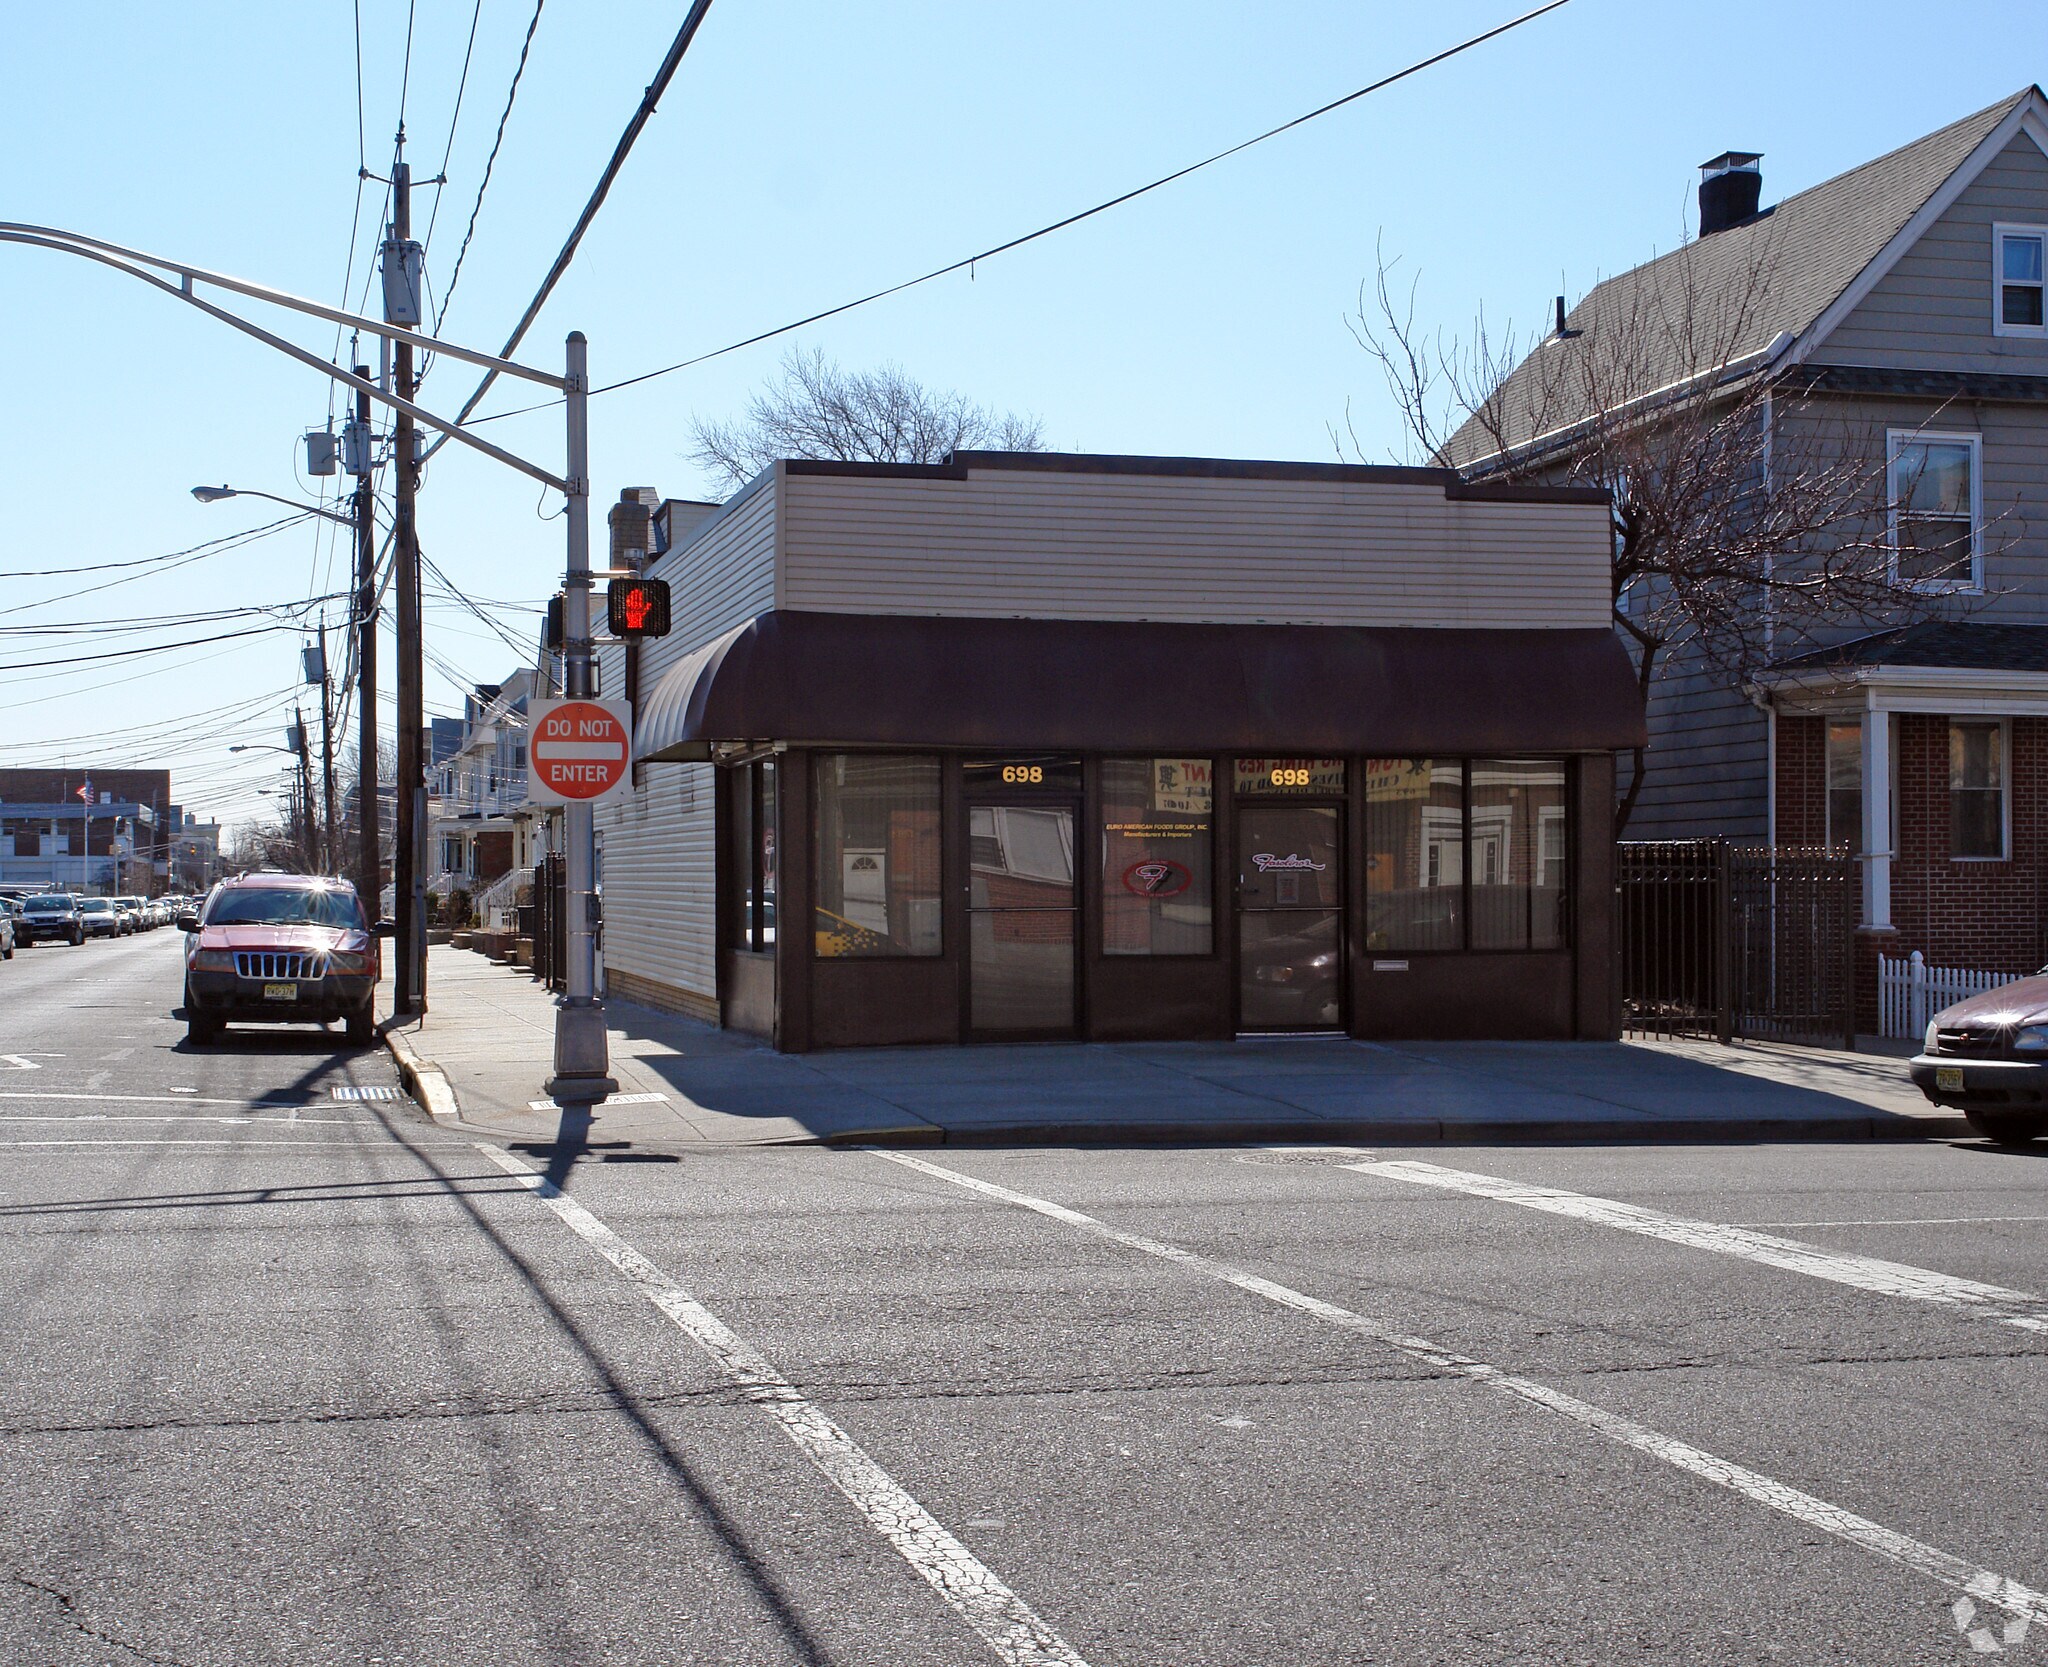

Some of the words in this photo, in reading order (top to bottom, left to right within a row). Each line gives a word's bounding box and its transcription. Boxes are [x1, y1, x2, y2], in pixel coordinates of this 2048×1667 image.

[547, 720, 571, 737] DO
[579, 720, 612, 737] NOT
[551, 765, 608, 782] ENTER
[1003, 766, 1043, 783] 698
[1271, 769, 1310, 785] 698
